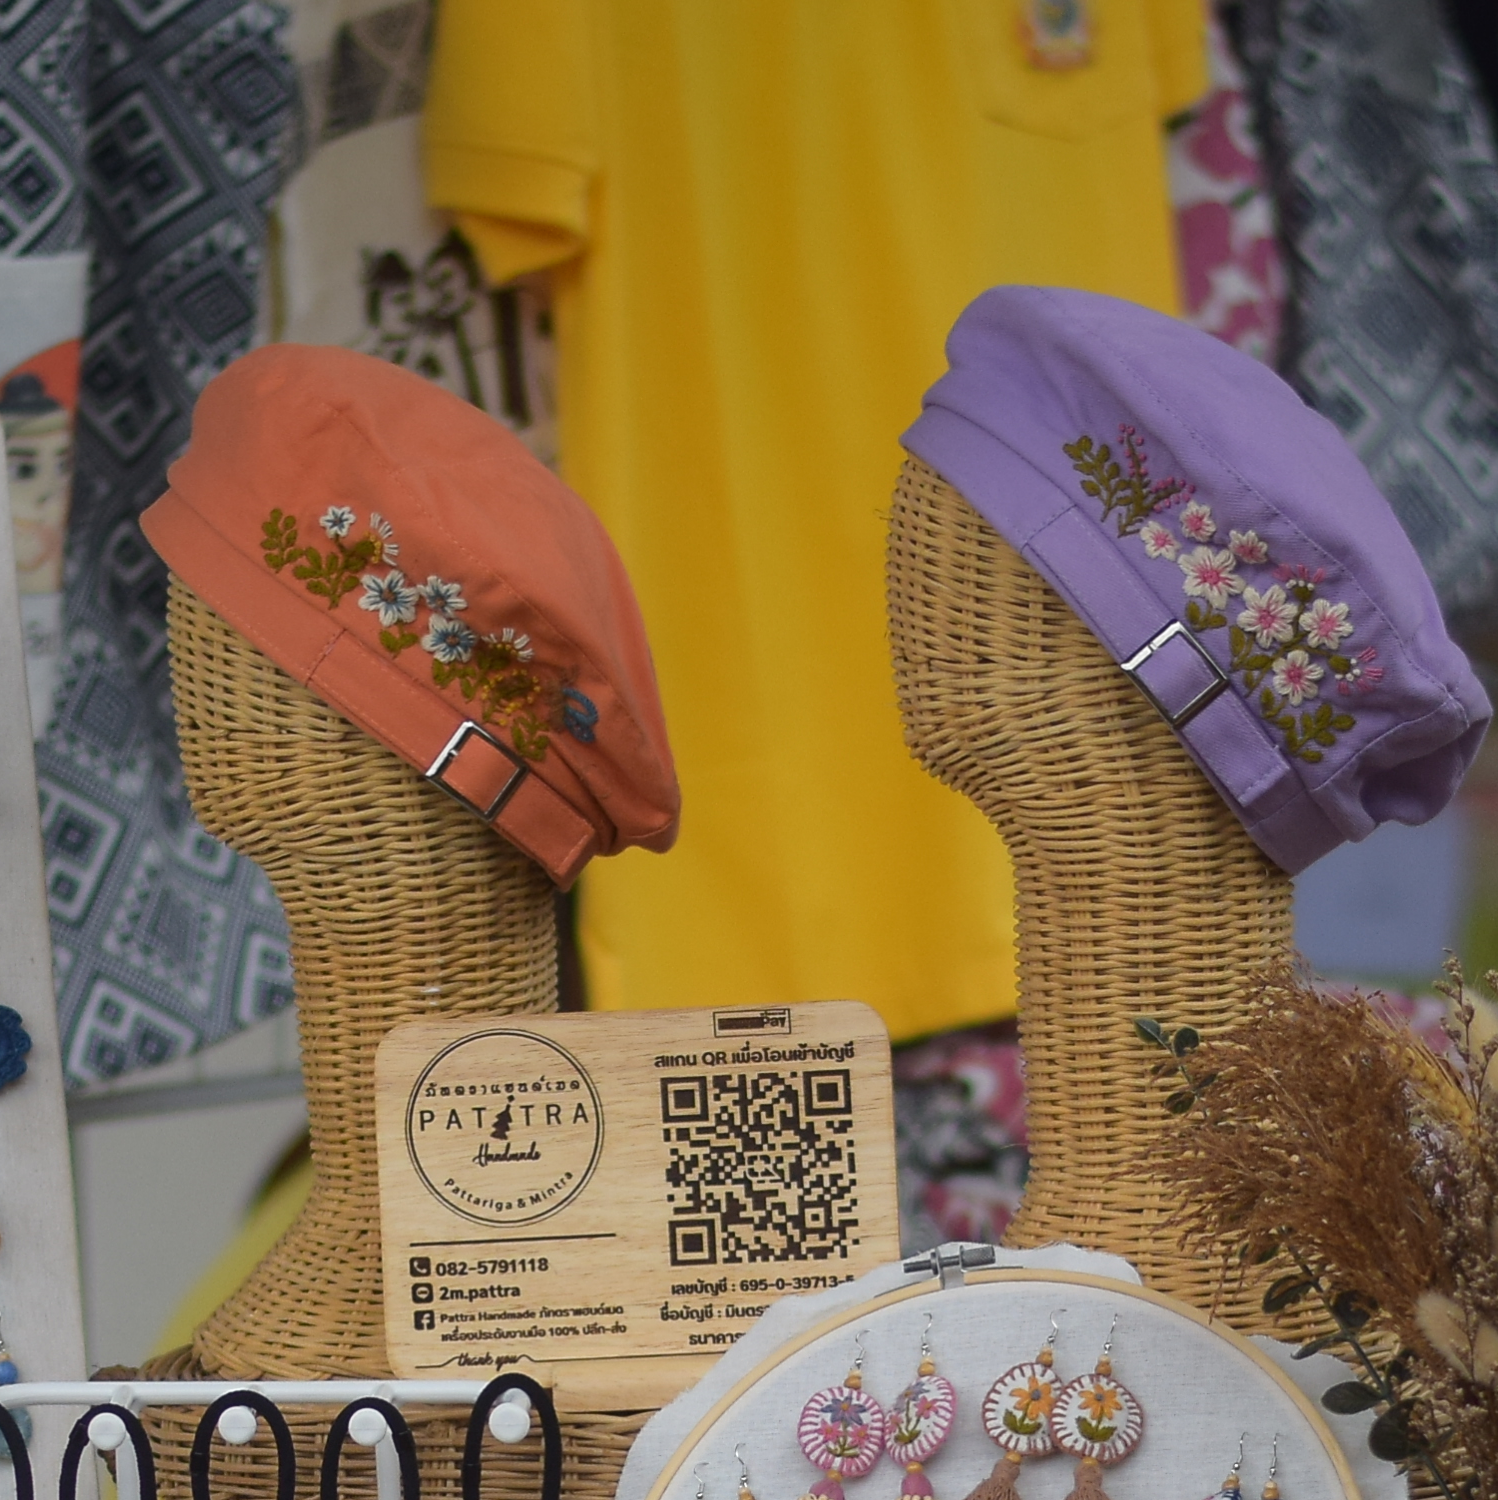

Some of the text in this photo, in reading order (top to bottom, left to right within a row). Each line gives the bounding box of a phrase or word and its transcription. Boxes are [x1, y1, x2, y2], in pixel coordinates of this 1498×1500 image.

[654, 1053, 697, 1069] สแกน
[701, 1051, 727, 1066] QR
[444, 1171, 574, 1212] Pattariga & Mintra
[435, 1257, 550, 1277] 082-5791118
[439, 1285, 521, 1302] 2m.pattra
[671, 1277, 728, 1296] เลขบัญชี
[440, 1312, 475, 1323] Pattra
[478, 1309, 536, 1322] Handmade
[659, 1301, 714, 1322] ชื่อบัญชี
[724, 1304, 770, 1319] มินตร
[548, 1326, 580, 1337] 100%
